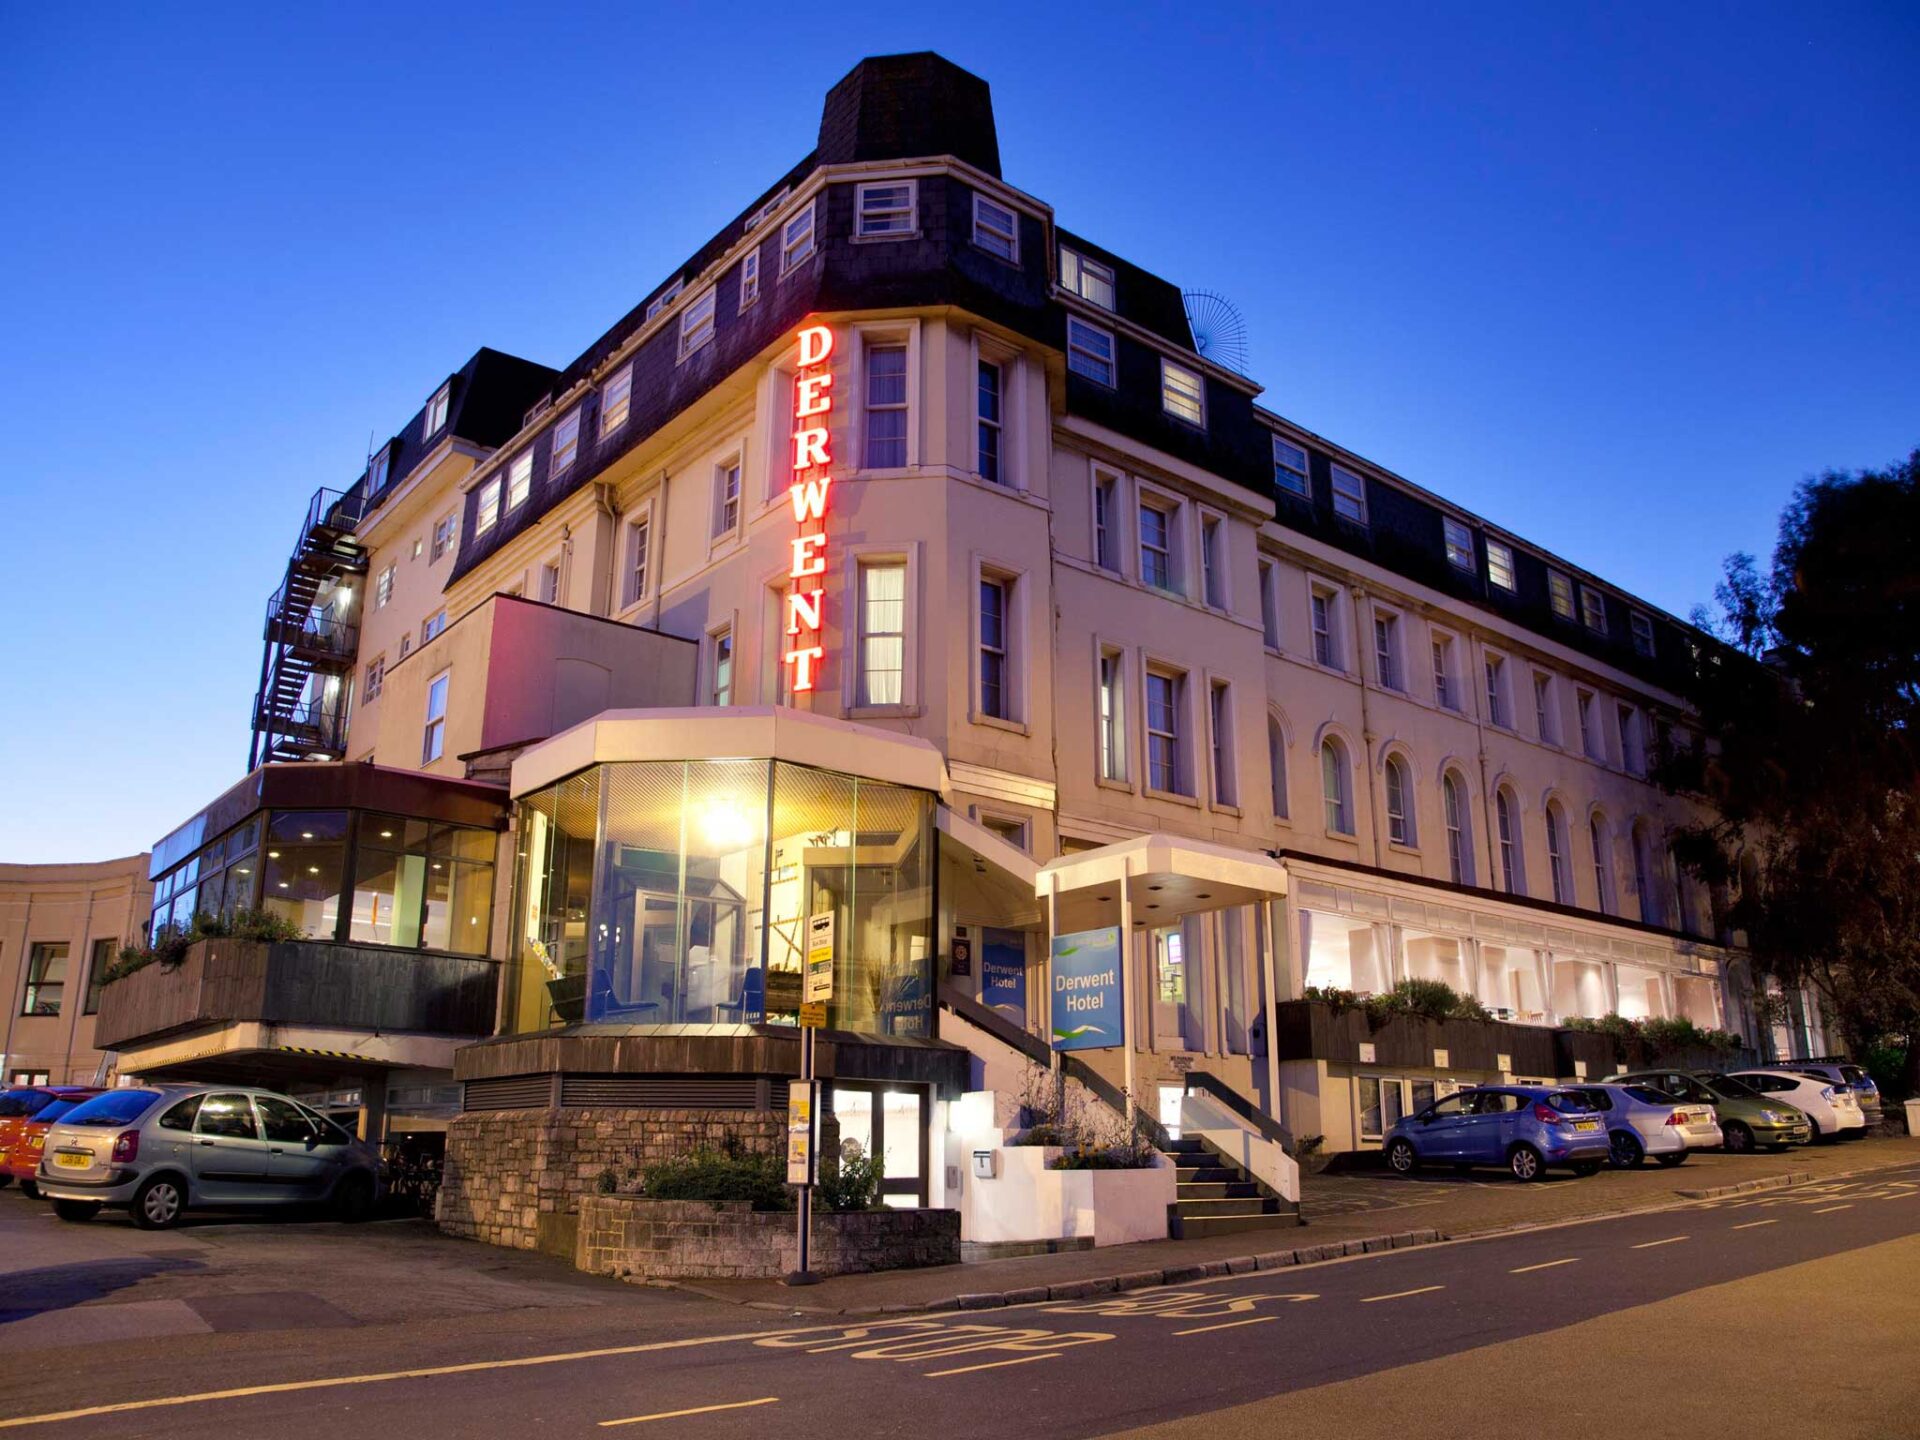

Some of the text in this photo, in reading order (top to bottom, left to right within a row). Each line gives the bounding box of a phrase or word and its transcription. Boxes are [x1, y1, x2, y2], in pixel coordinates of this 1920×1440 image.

[785, 325, 834, 692] DERWENT
[983, 961, 1023, 977] Derwent
[991, 976, 1017, 988] Hotel
[1055, 970, 1115, 992] Derwent
[1066, 991, 1104, 1012] Hotel
[1040, 1292, 1321, 1318] BUS
[752, 1322, 1116, 1361] STOP
